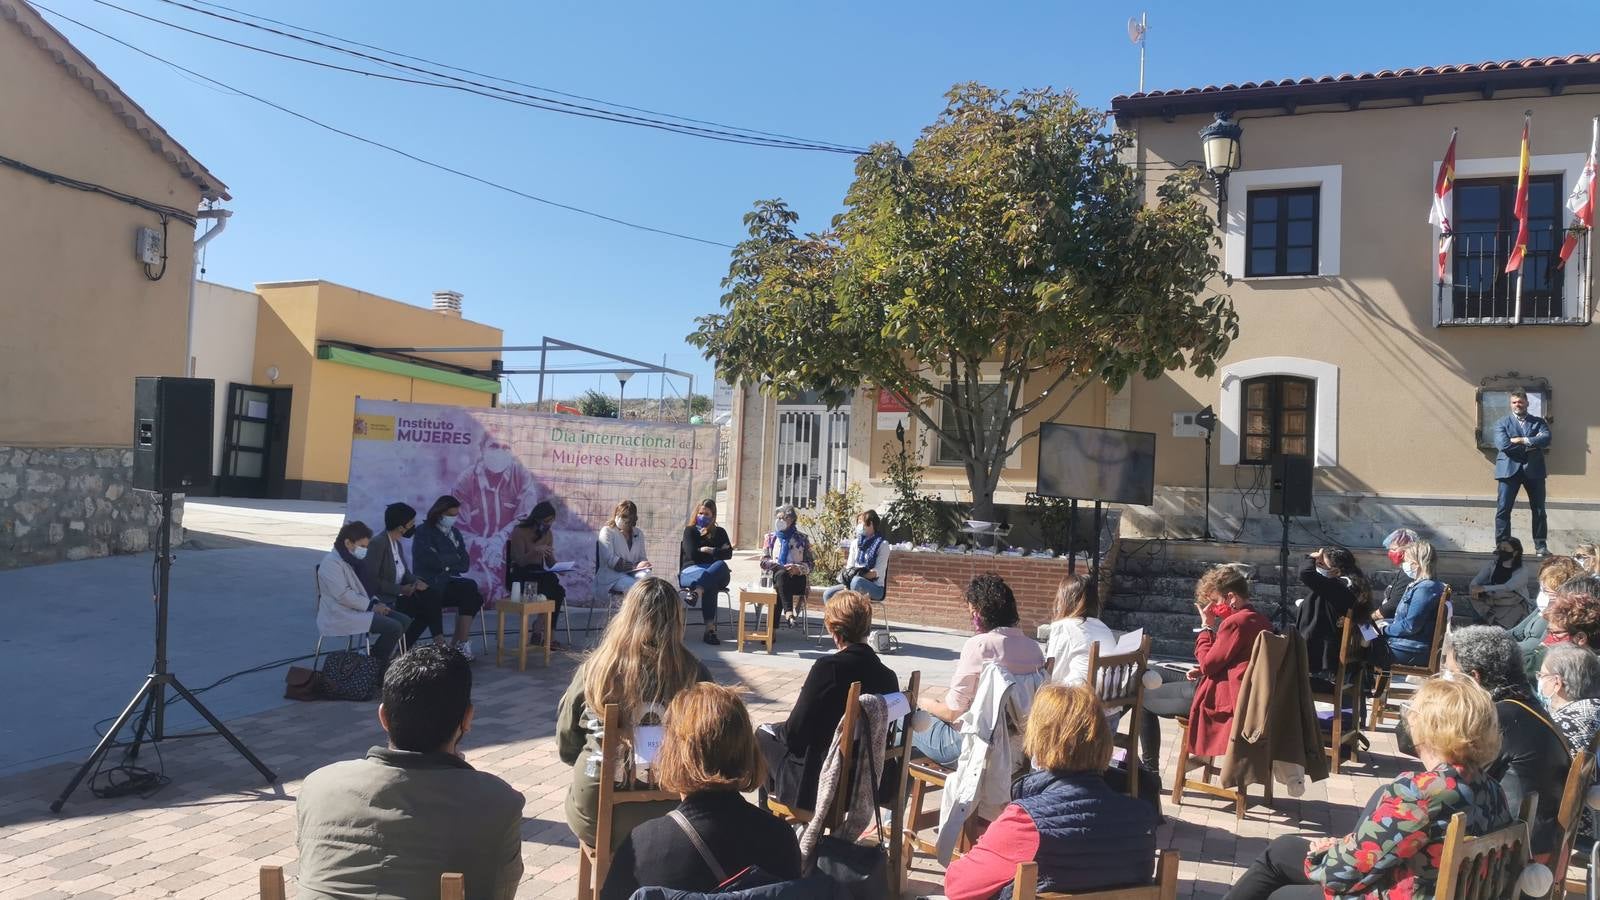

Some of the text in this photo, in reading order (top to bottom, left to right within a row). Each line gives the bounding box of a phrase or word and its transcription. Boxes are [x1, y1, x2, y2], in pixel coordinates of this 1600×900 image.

[398, 417, 455, 430] Instituto
[397, 429, 472, 445] MUJERES
[580, 429, 676, 449] internacional
[552, 449, 700, 470] Mujeres Rurales 2021
